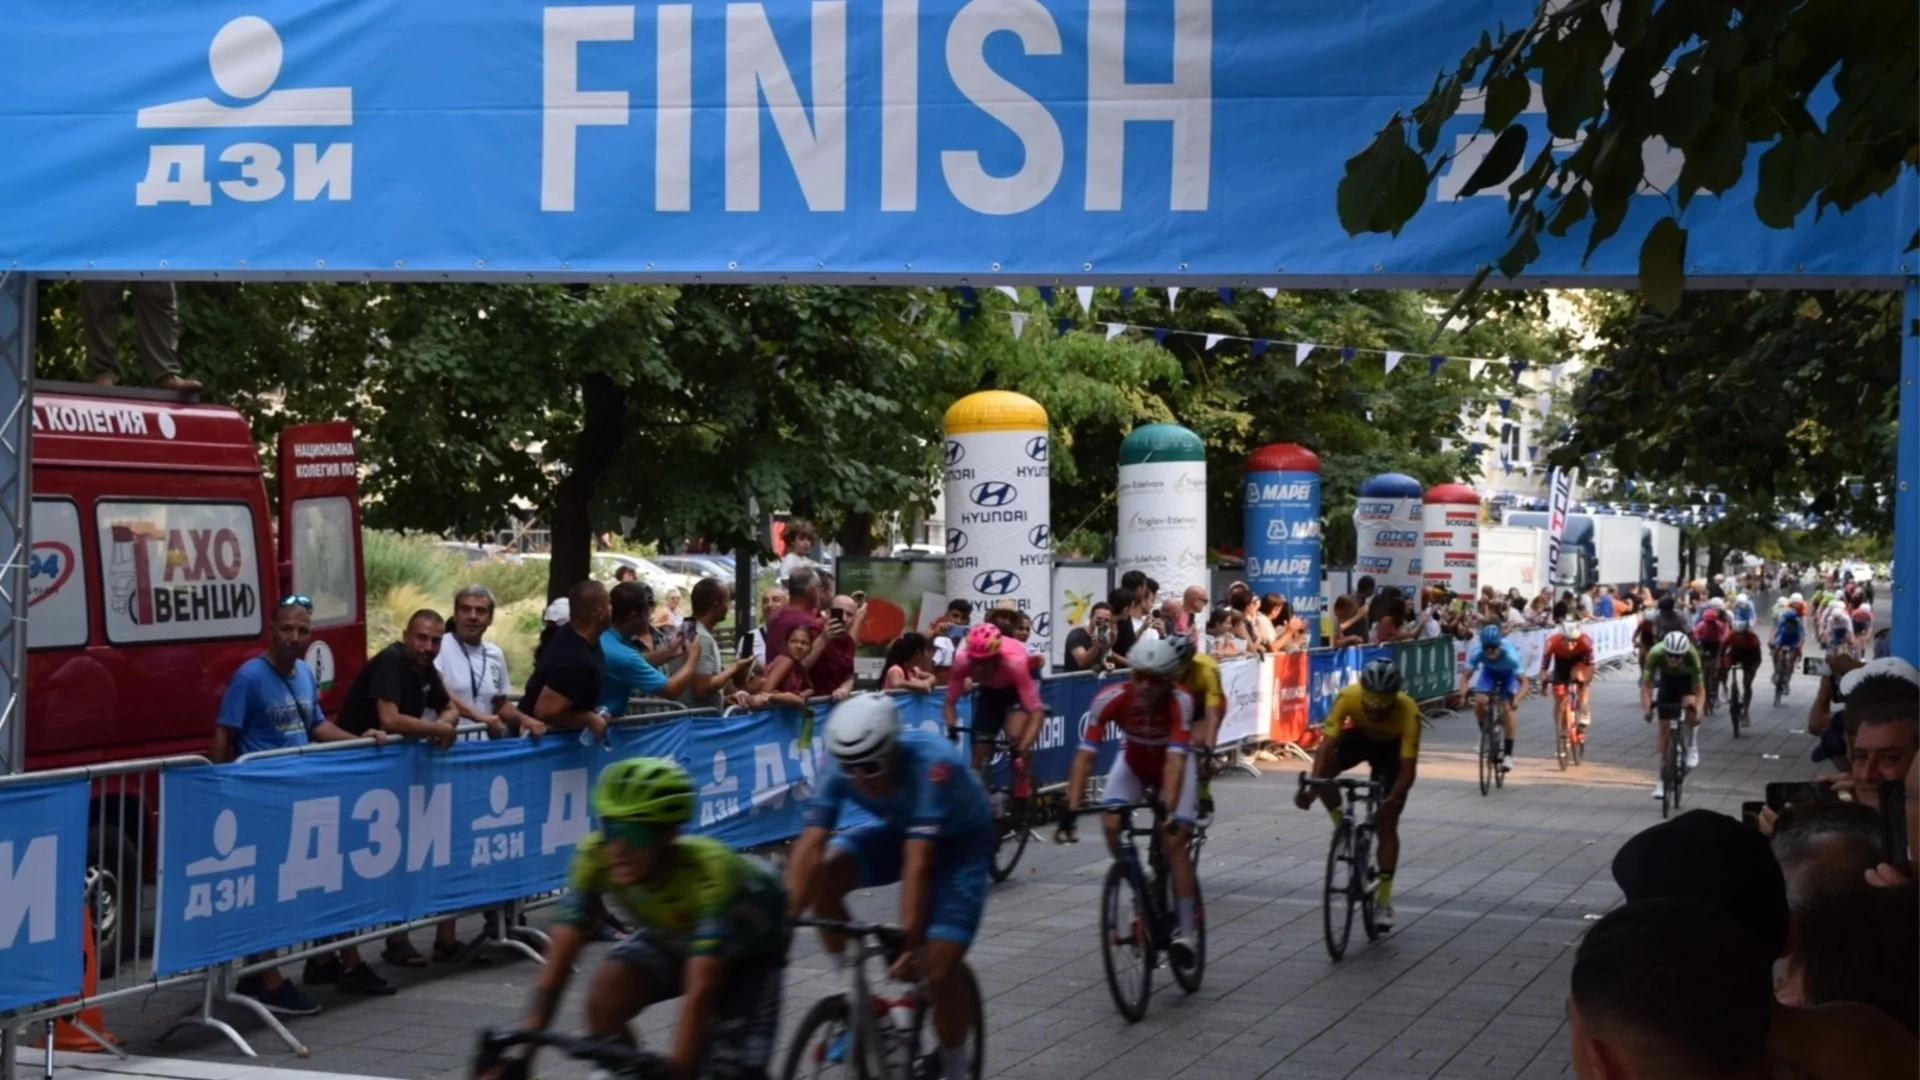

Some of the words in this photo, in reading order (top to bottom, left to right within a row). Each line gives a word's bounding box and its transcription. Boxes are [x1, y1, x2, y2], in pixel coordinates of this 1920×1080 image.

[541, 0, 1212, 215] FINISH
[136, 142, 353, 206] ДЗИ
[45, 406, 148, 435] КОЛЕГИЯ
[294, 442, 354, 459] НАЦИОНАЛНА
[295, 463, 340, 478] КОЛЕГИЯ
[341, 461, 355, 476] ПО
[1262, 483, 1312, 500] MAPEI
[962, 510, 1028, 523] HYUNDAI
[1263, 558, 1312, 575] MAPEI
[278, 782, 452, 901] ДЗИ
[471, 831, 525, 868] ДЗИ
[184, 874, 256, 921] ДЗИ
